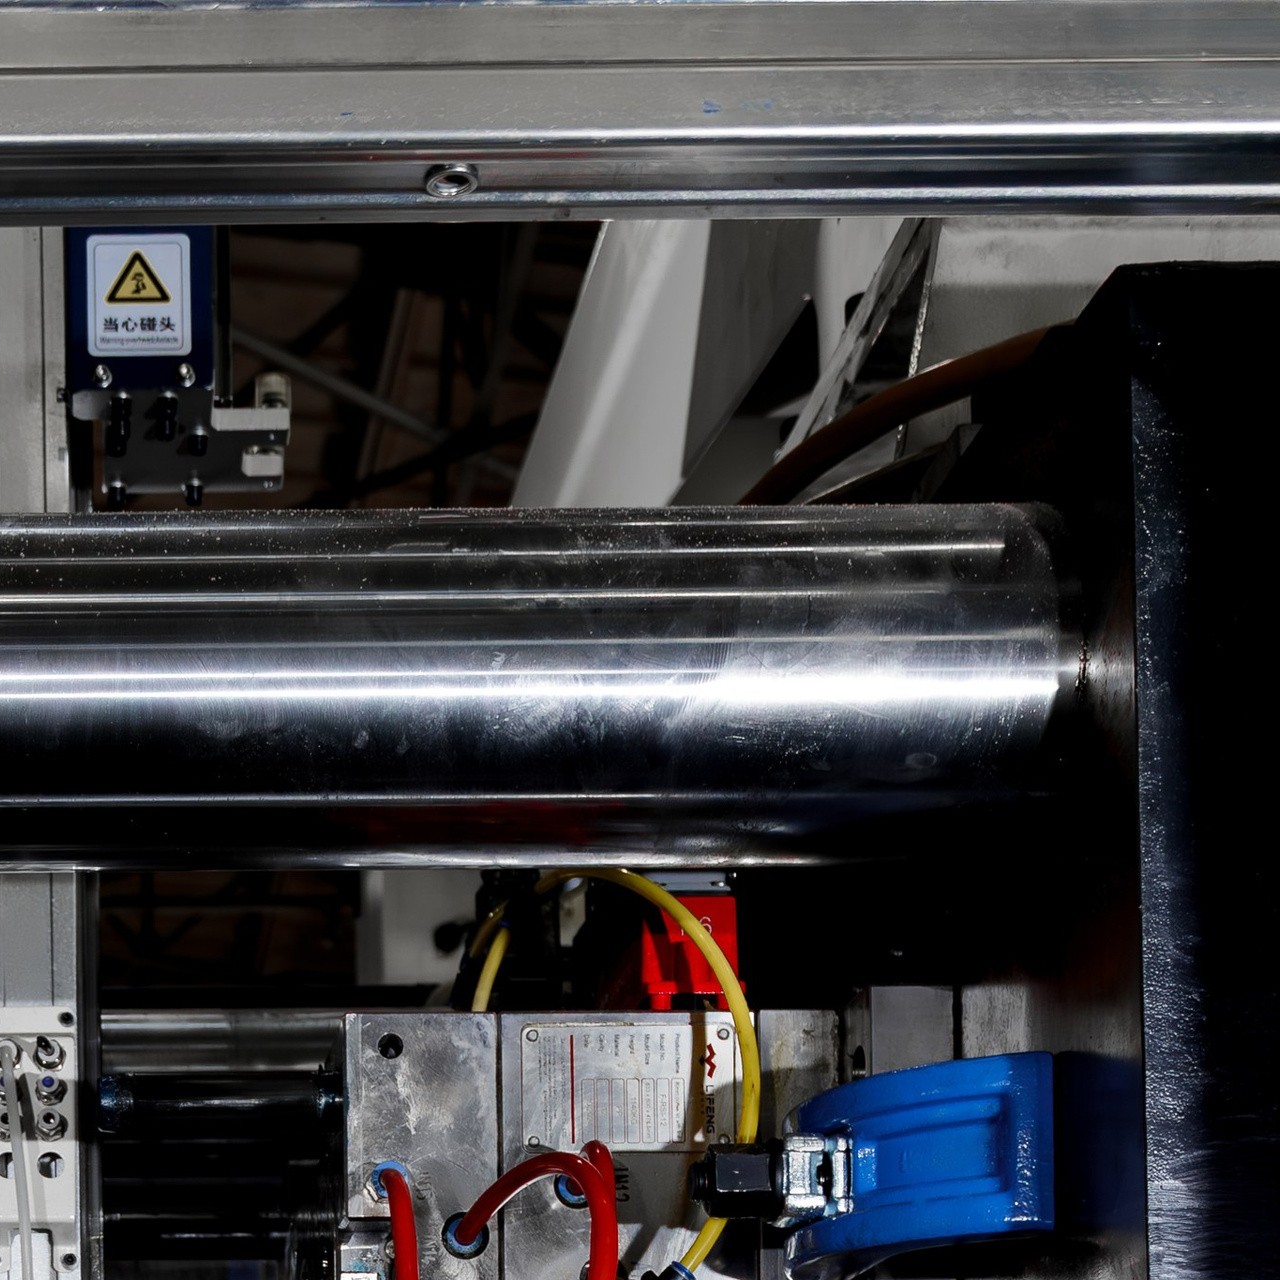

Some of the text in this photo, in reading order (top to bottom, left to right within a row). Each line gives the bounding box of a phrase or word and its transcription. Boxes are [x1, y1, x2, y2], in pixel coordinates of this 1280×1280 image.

[103, 316, 176, 332] 当心碰头
[706, 1085, 716, 1134] LIFENG
